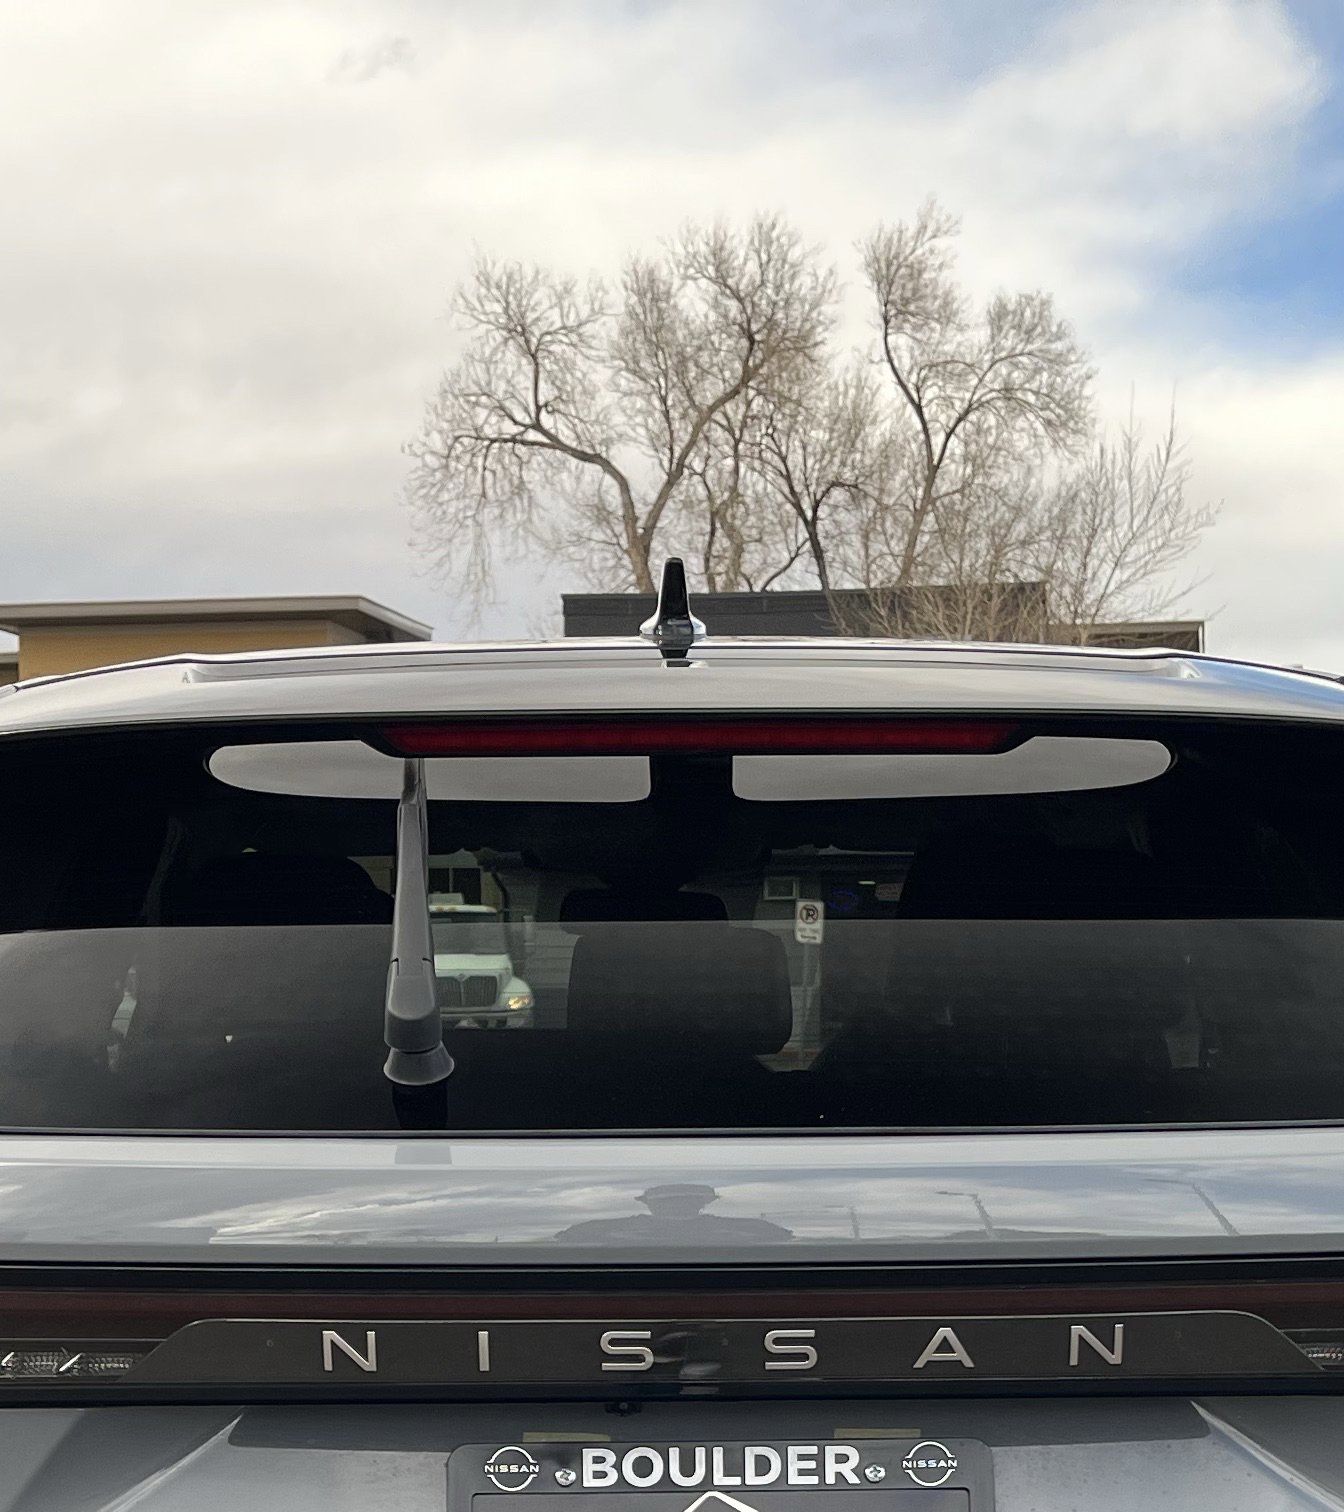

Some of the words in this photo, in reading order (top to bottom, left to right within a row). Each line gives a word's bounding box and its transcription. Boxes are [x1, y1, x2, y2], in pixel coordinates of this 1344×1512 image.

[322, 1322, 1124, 1373] NISSAN
[484, 1464, 540, 1473] NISSAN
[581, 1445, 861, 1487] BOULDER
[902, 1459, 958, 1468] NISSAN
